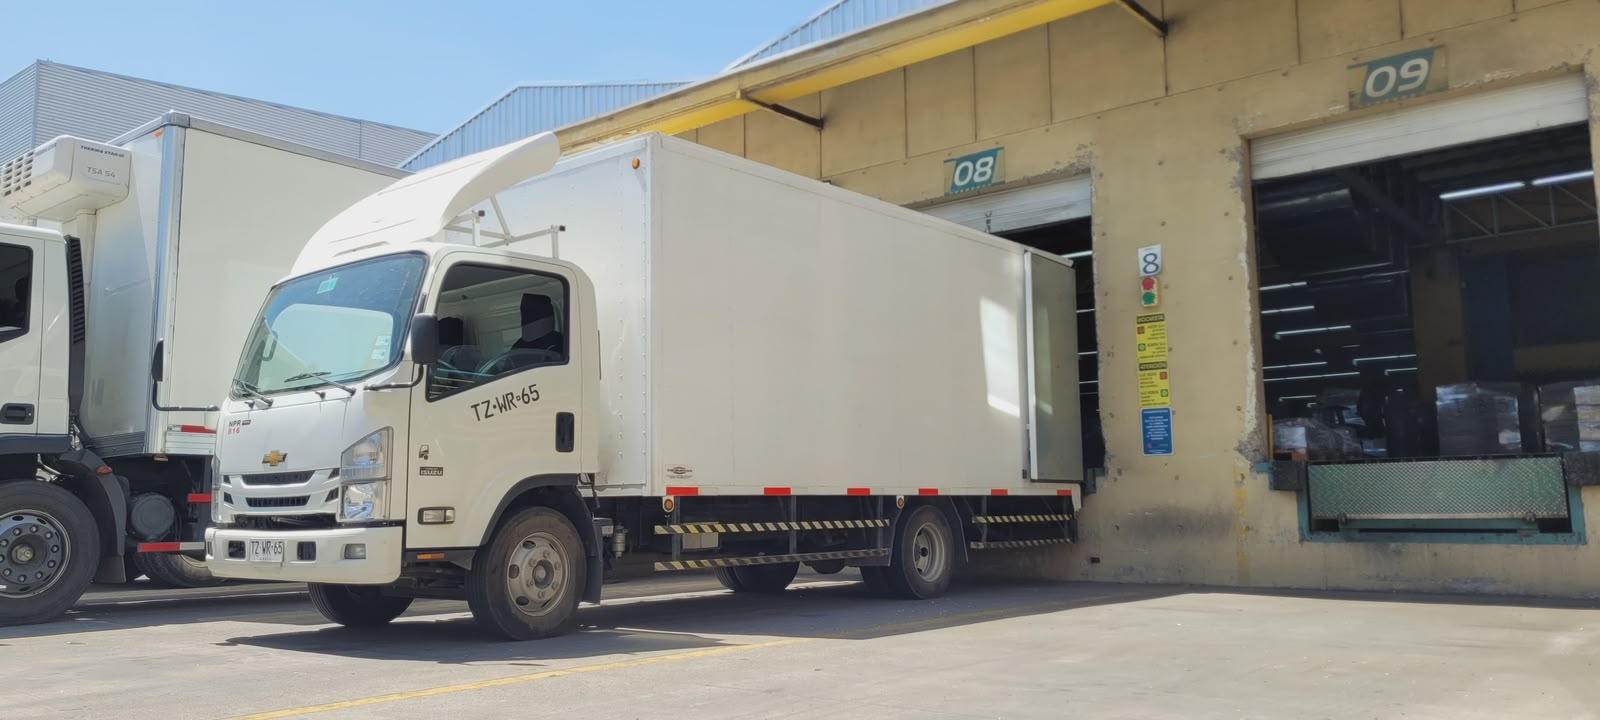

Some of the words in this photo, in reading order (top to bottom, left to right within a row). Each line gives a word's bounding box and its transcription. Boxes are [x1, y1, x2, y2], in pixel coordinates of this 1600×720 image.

[1365, 58, 1429, 97] 09
[87, 167, 103, 176] TSA
[105, 170, 116, 178] 54
[954, 156, 994, 186] 08
[1142, 252, 1160, 274] 8
